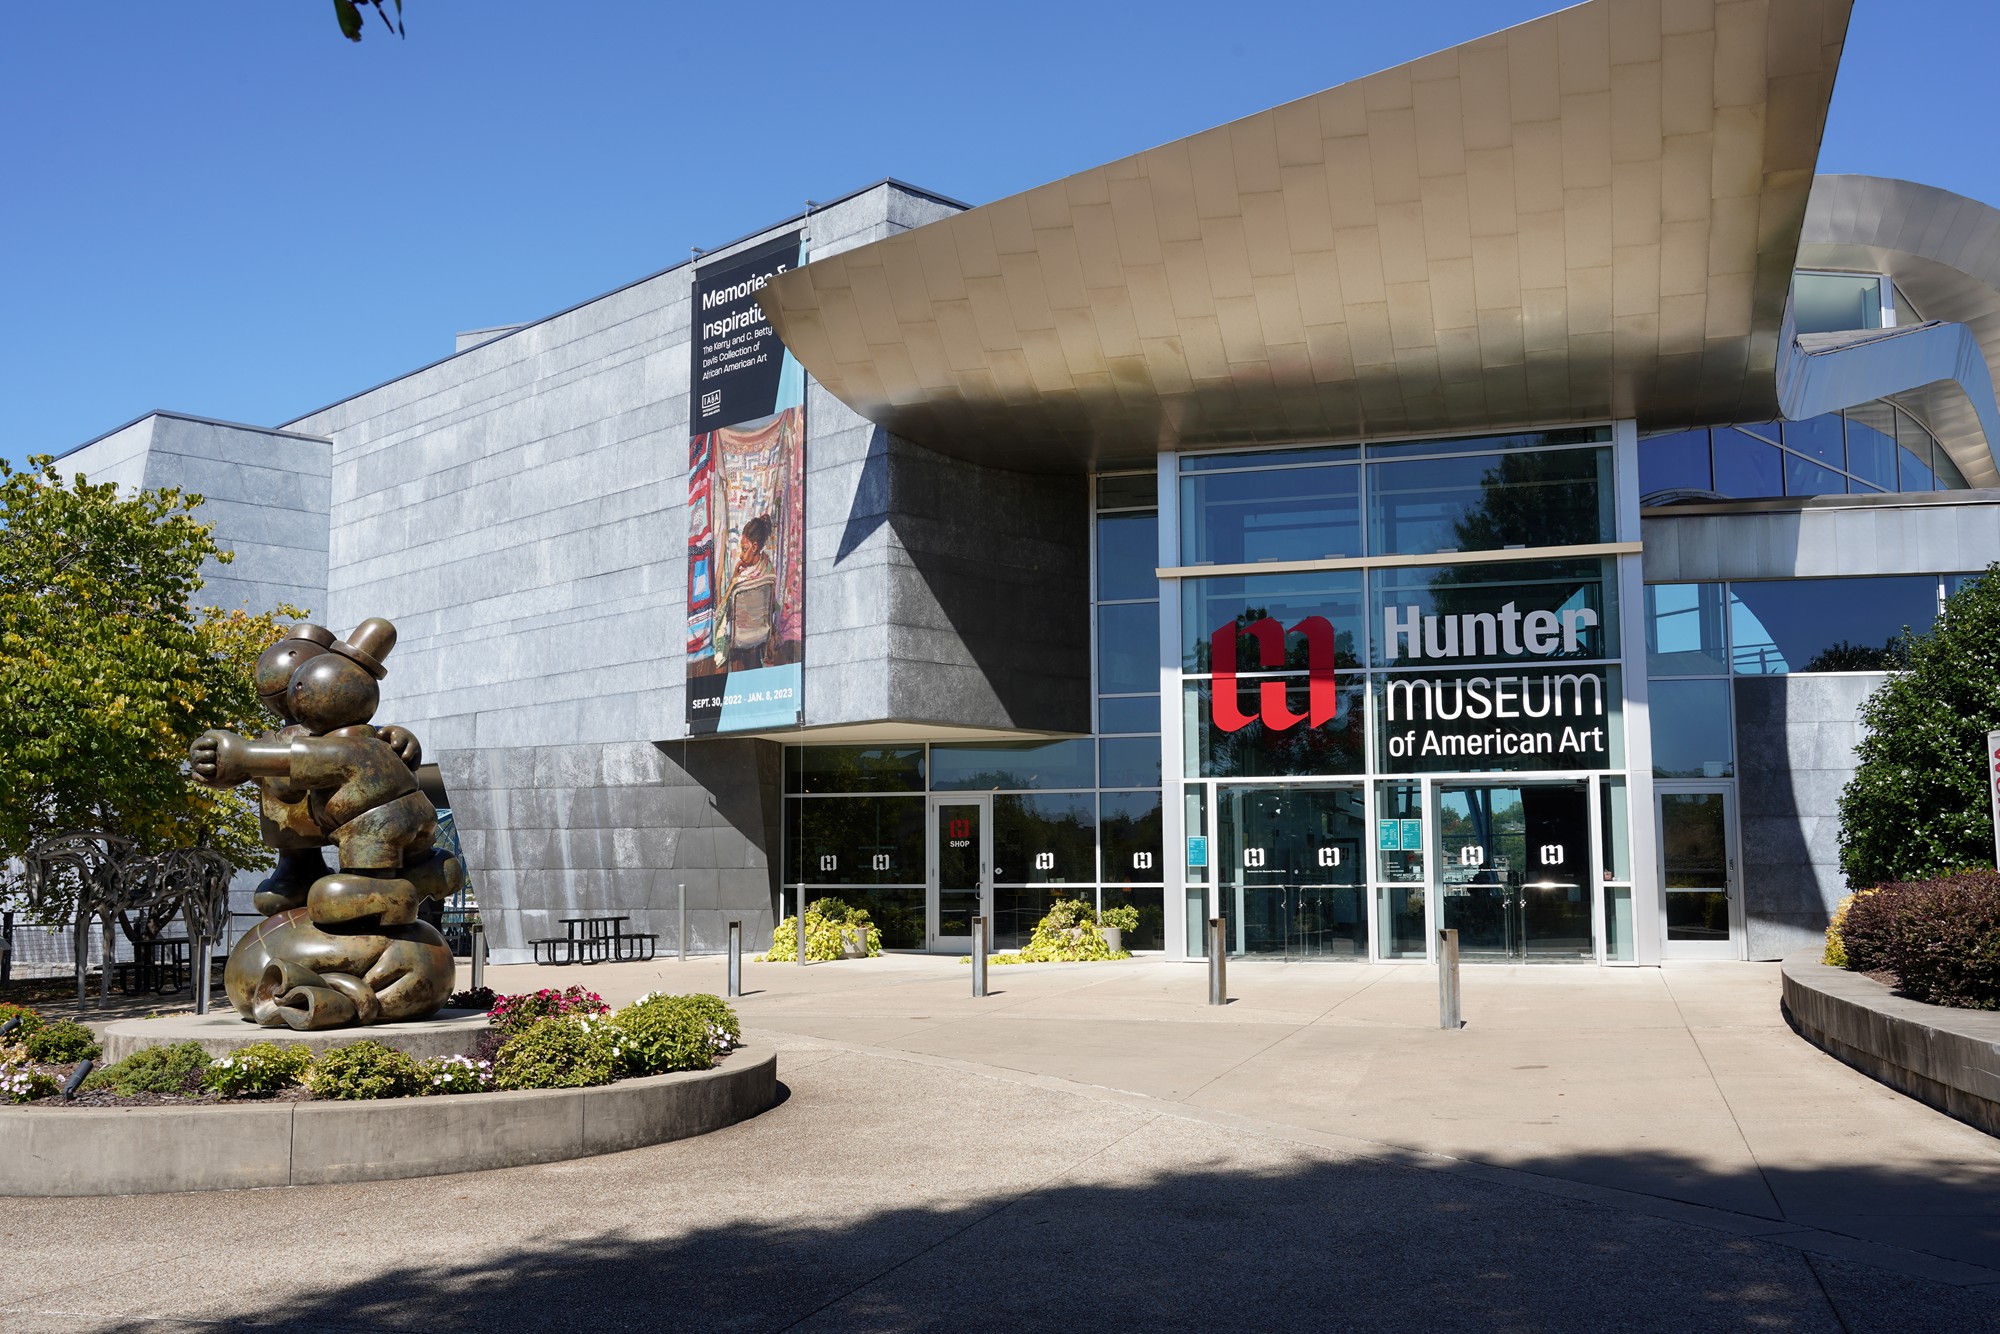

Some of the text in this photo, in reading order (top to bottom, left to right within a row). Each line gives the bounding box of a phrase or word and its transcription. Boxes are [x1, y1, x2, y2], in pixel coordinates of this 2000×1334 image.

[702, 340, 761, 368] Davis Collection of
[703, 326, 773, 355] The Kerry and C. Betty
[702, 353, 768, 381] African American Art
[1384, 600, 1598, 660] Hunter
[692, 698, 711, 709] SEPT.
[711, 696, 723, 707] 30,
[723, 694, 742, 706] 2022
[747, 691, 764, 703] JAN.
[765, 691, 773, 702] 8,
[773, 687, 793, 699] 2023
[1386, 673, 1603, 721] MUSEUM
[1389, 726, 1604, 758] of American Art
[949, 840, 970, 848] SHOP
